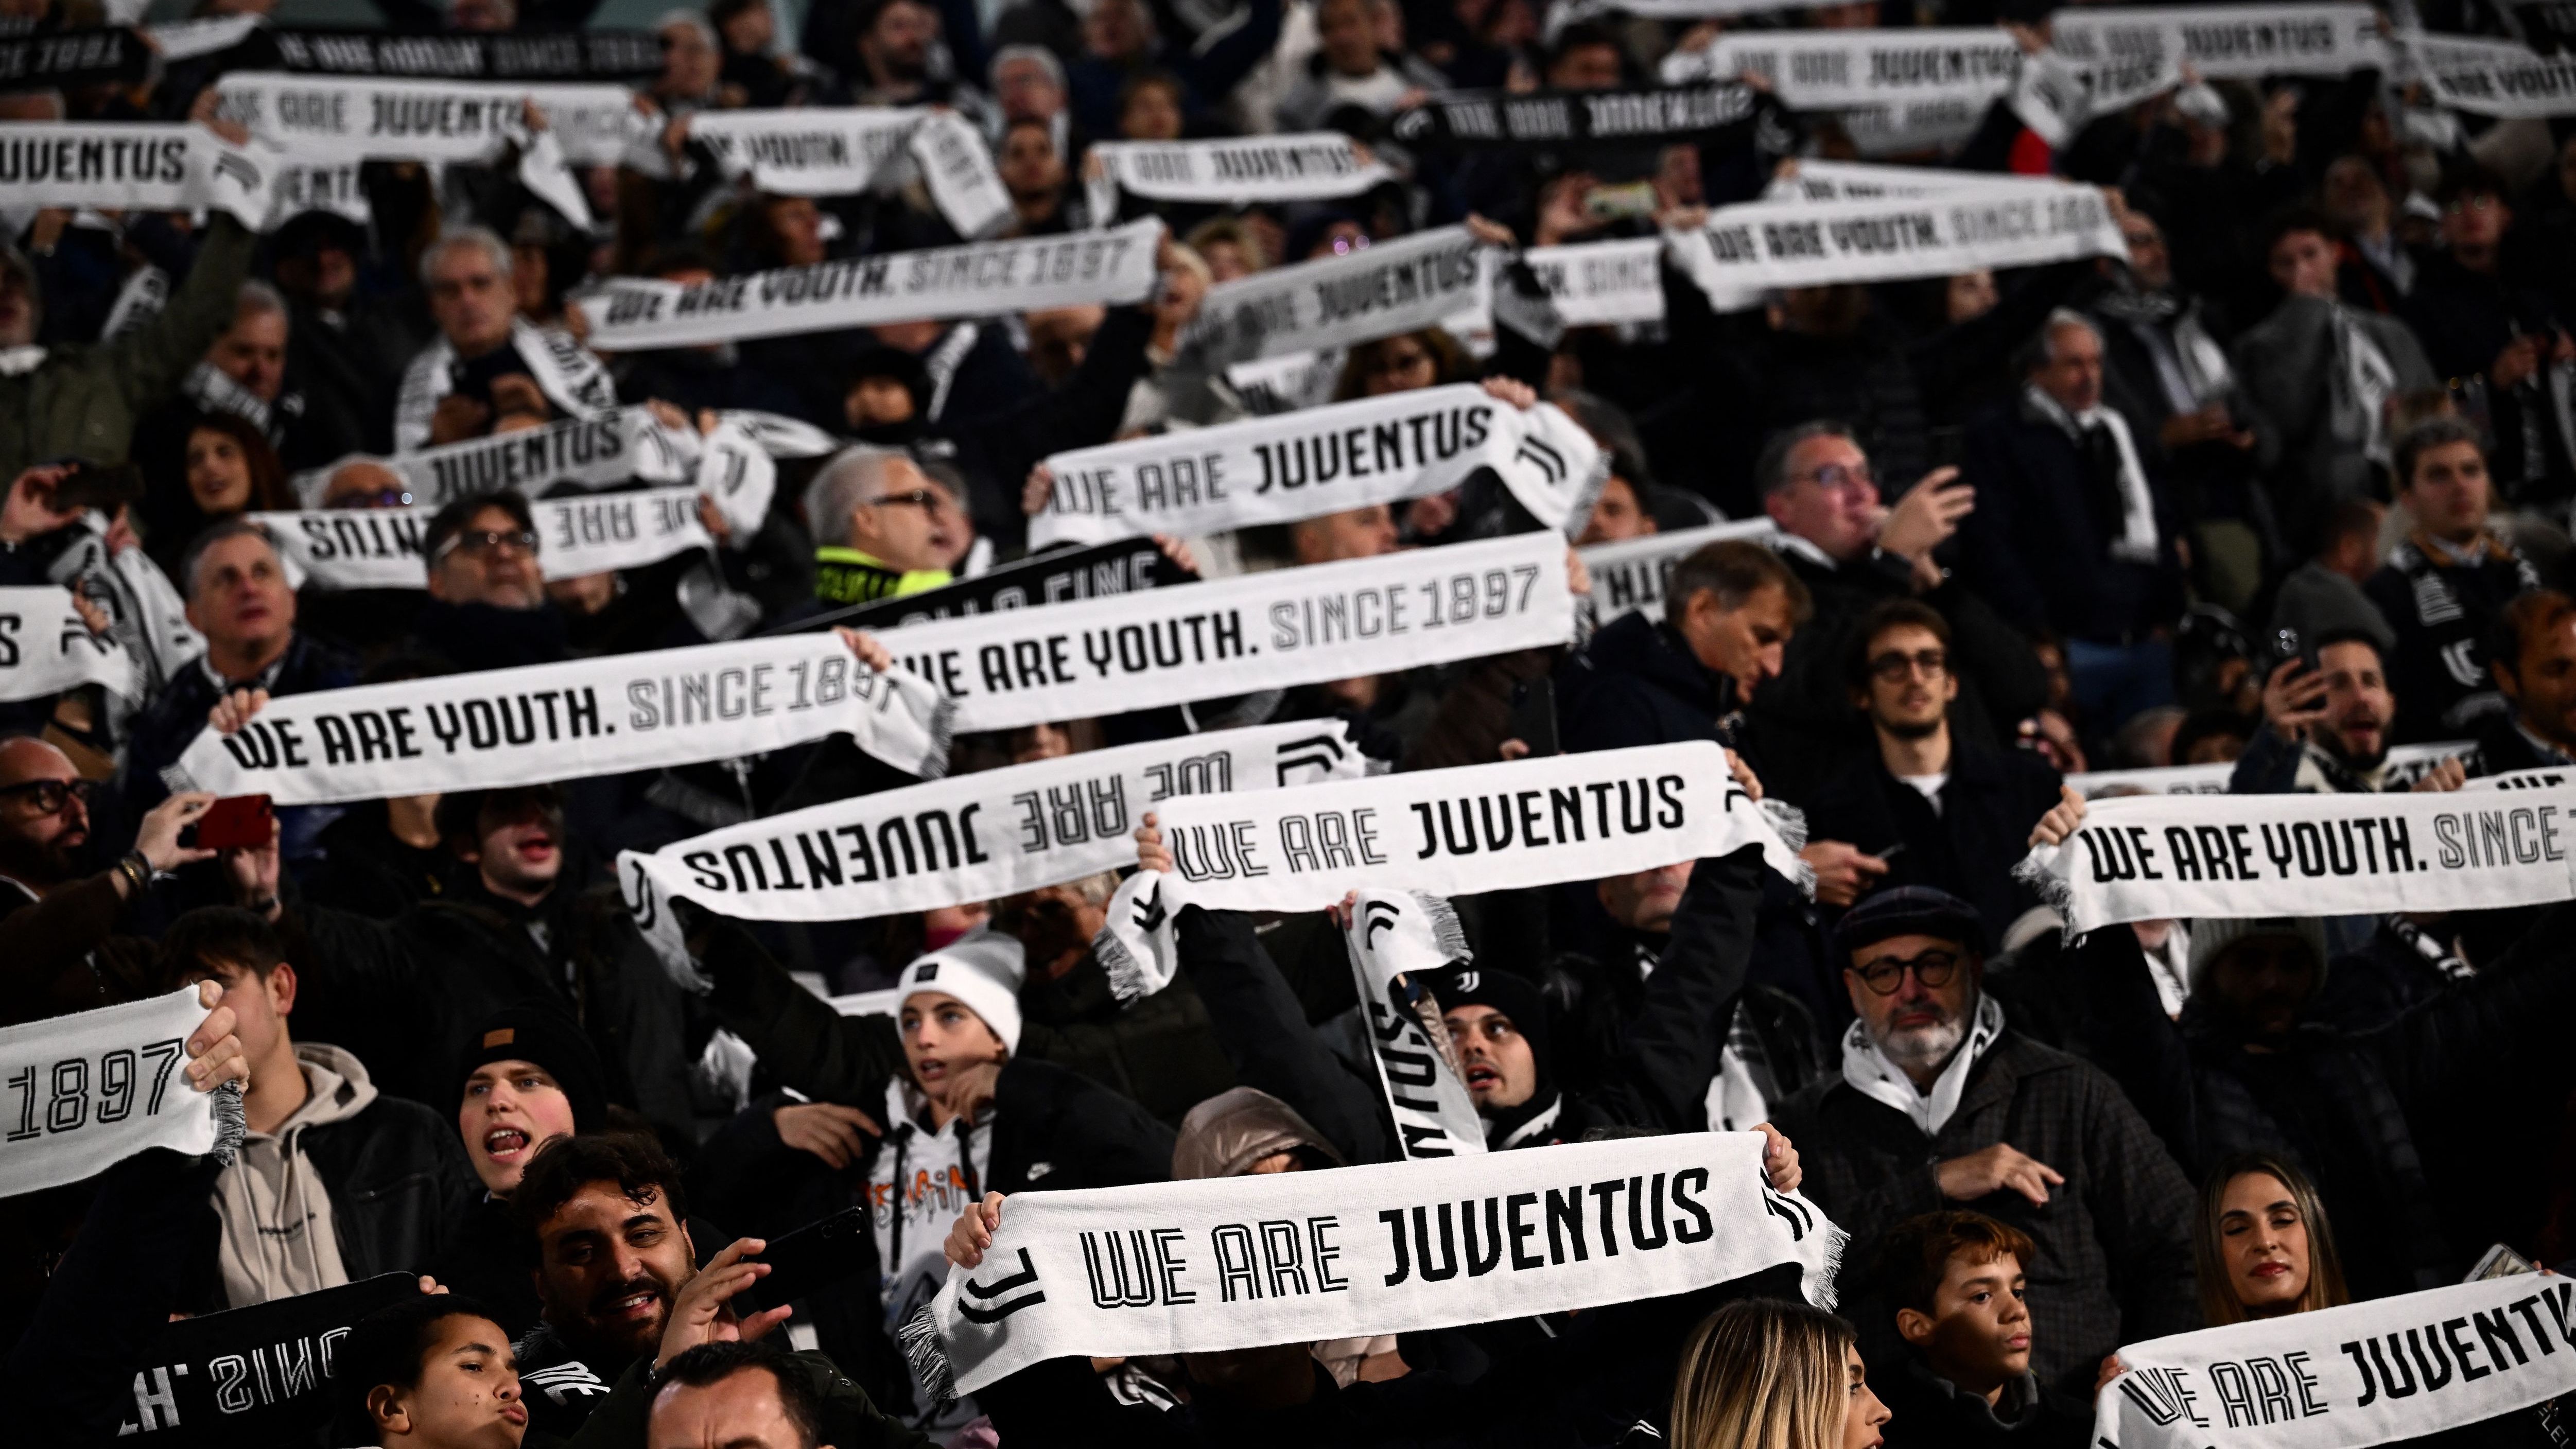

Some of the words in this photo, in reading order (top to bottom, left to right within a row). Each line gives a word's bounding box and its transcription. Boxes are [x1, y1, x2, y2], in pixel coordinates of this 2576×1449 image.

[433, 416, 622, 499] JUVENTUS
[1053, 470, 1124, 515] WE
[1137, 452, 1228, 512] ARE
[1252, 406, 1493, 495] JUVENTUS
[980, 635, 1077, 692] ARE
[1083, 609, 1258, 676] YOUTH.
[1270, 585, 1408, 652] SINCE
[1421, 562, 1540, 629] 1897
[222, 719, 309, 770] WE
[315, 707, 421, 766] ARE
[426, 688, 615, 752] YOUTH.
[628, 664, 772, 731] SINCE
[684, 802, 986, 891] JUVENTUS
[1014, 774, 1126, 852] ARE
[1172, 822, 1268, 882] WE
[1280, 808, 1387, 872] ARE
[1410, 775, 1684, 860] JUVENTUS
[2078, 825, 2162, 883] WE
[2164, 825, 2259, 881] ARE
[2259, 817, 2428, 878] YOUTH.
[2433, 807, 2565, 869] SINCE
[8, 1037, 183, 1142] 1897
[1078, 1227, 1197, 1310] WE
[1211, 1215, 1350, 1304] ARE
[1380, 1167, 1716, 1288] JUVENTUS
[2208, 1351, 2329, 1428] ARE
[2341, 1283, 2576, 1408] JUVENTU
